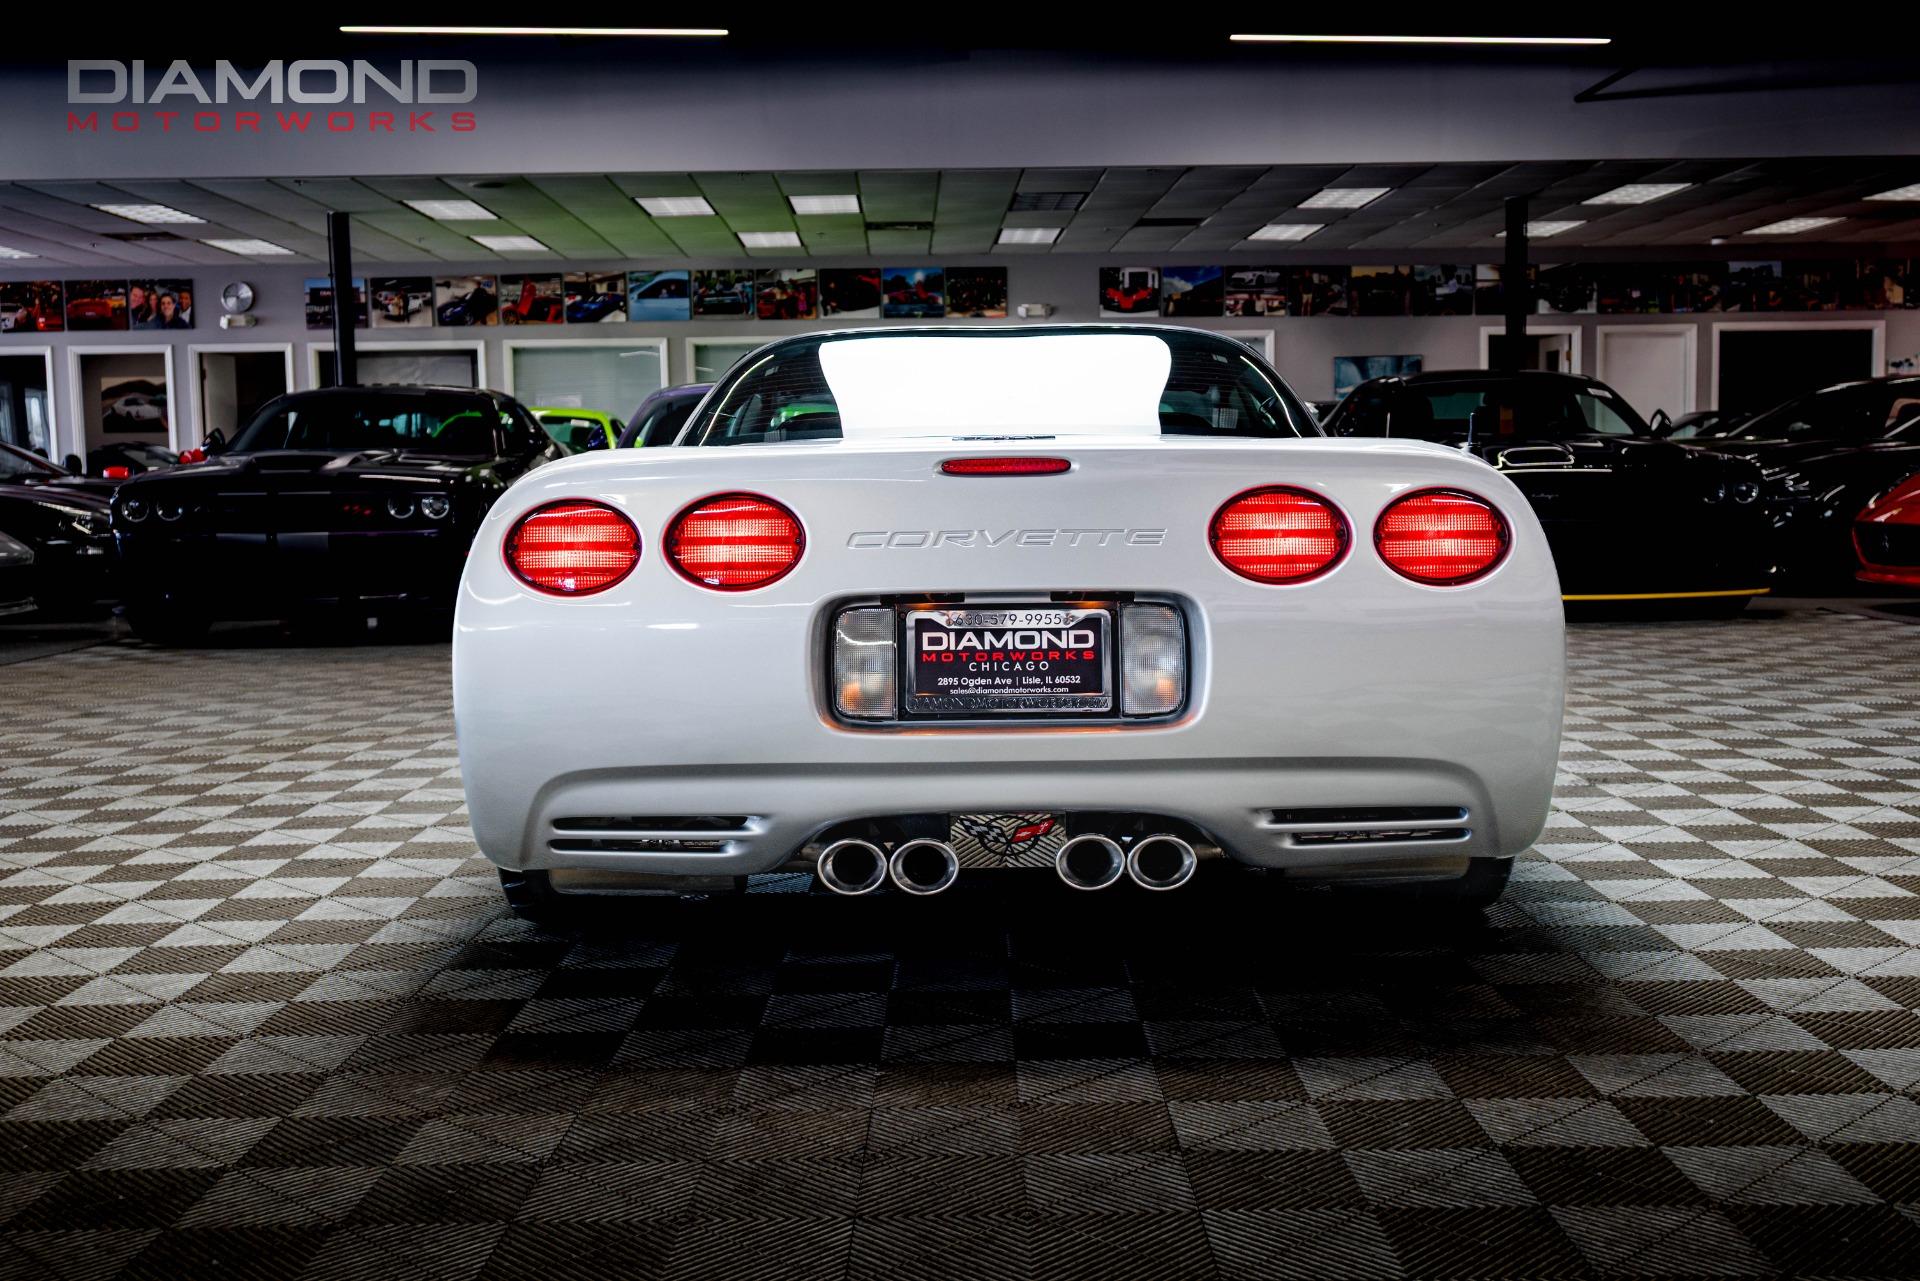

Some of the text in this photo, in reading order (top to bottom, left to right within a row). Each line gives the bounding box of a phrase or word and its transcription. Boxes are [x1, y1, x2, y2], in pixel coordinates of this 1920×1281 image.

[846, 528, 1168, 549] CORVETTE
[956, 613, 1062, 626] 630-579-9955
[922, 630, 1095, 650] DIAMOND
[922, 650, 1095, 662] MOTORWORKS
[968, 661, 1049, 672] CHICAGO
[937, 677, 959, 686] 2895
[961, 677, 992, 688] Ogden
[995, 677, 1013, 685] Ave
[1022, 676, 1044, 686] Lisle,
[1045, 676, 1053, 684] IL
[1055, 675, 1081, 684] 60532
[949, 685, 1069, 695] sales@diamondmotorworks.com
